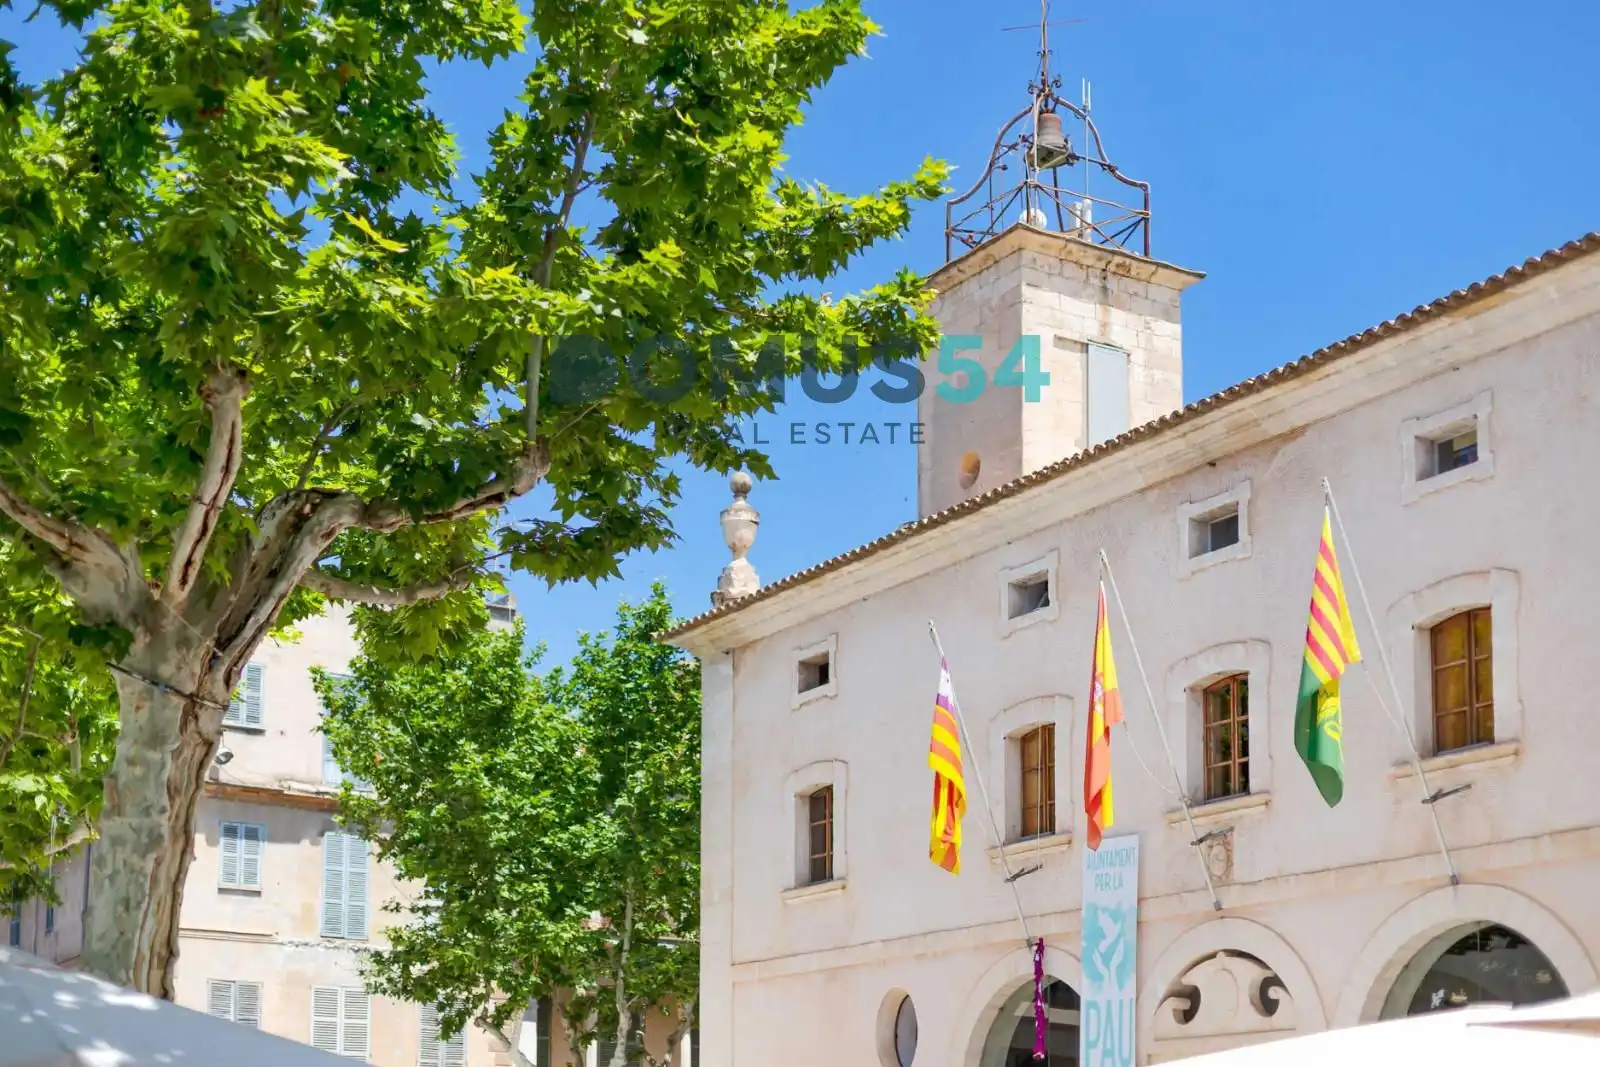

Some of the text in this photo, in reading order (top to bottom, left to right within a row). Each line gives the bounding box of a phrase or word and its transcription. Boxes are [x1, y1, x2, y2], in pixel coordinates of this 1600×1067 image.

[1094, 871, 1124, 892] PER LA
[1084, 998, 1134, 1067] PAU
